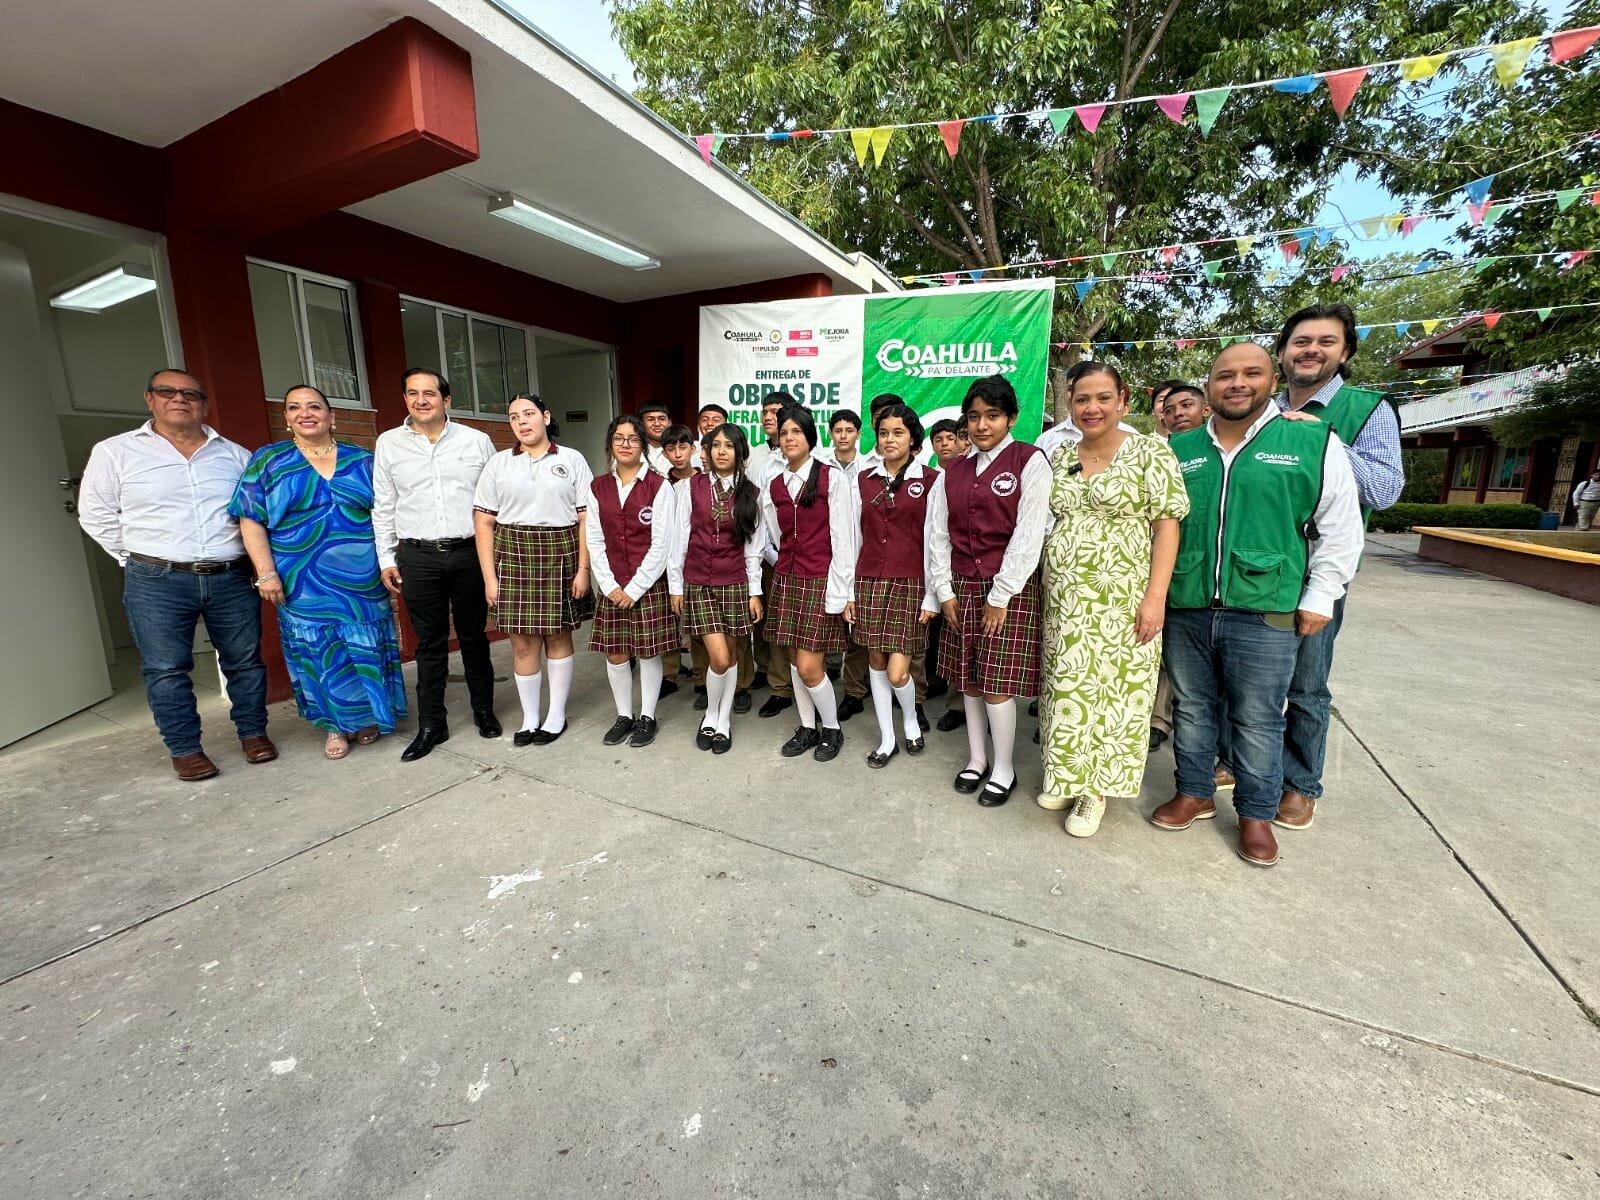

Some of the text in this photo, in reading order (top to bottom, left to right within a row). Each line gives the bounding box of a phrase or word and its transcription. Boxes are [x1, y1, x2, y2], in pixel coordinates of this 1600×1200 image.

[724, 330, 763, 340] COAHUILA
[876, 339, 1017, 371] COAHUILA
[755, 369, 811, 380] ENTREGA DE
[945, 365, 991, 374] DELANTE
[810, 382, 840, 405] DE
[1254, 452, 1300, 462] COAHUILA
